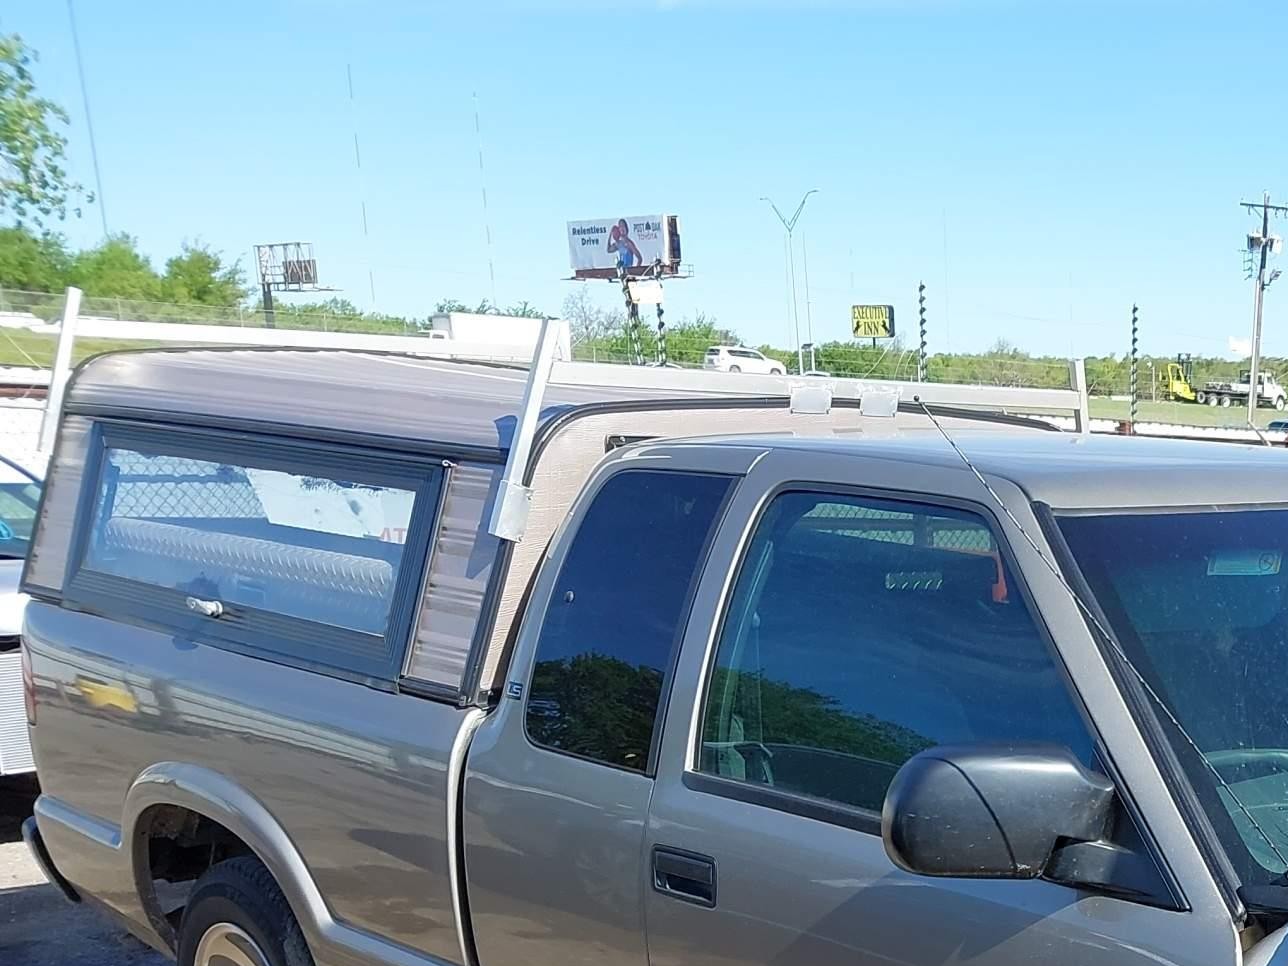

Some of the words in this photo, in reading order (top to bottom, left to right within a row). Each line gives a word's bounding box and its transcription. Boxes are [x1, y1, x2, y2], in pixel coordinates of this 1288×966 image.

[572, 225, 607, 236] Relentless
[581, 238, 600, 246] Drive
[853, 305, 889, 320] EXECUTIVE
[863, 321, 880, 336] INN
[507, 682, 523, 698] LS
